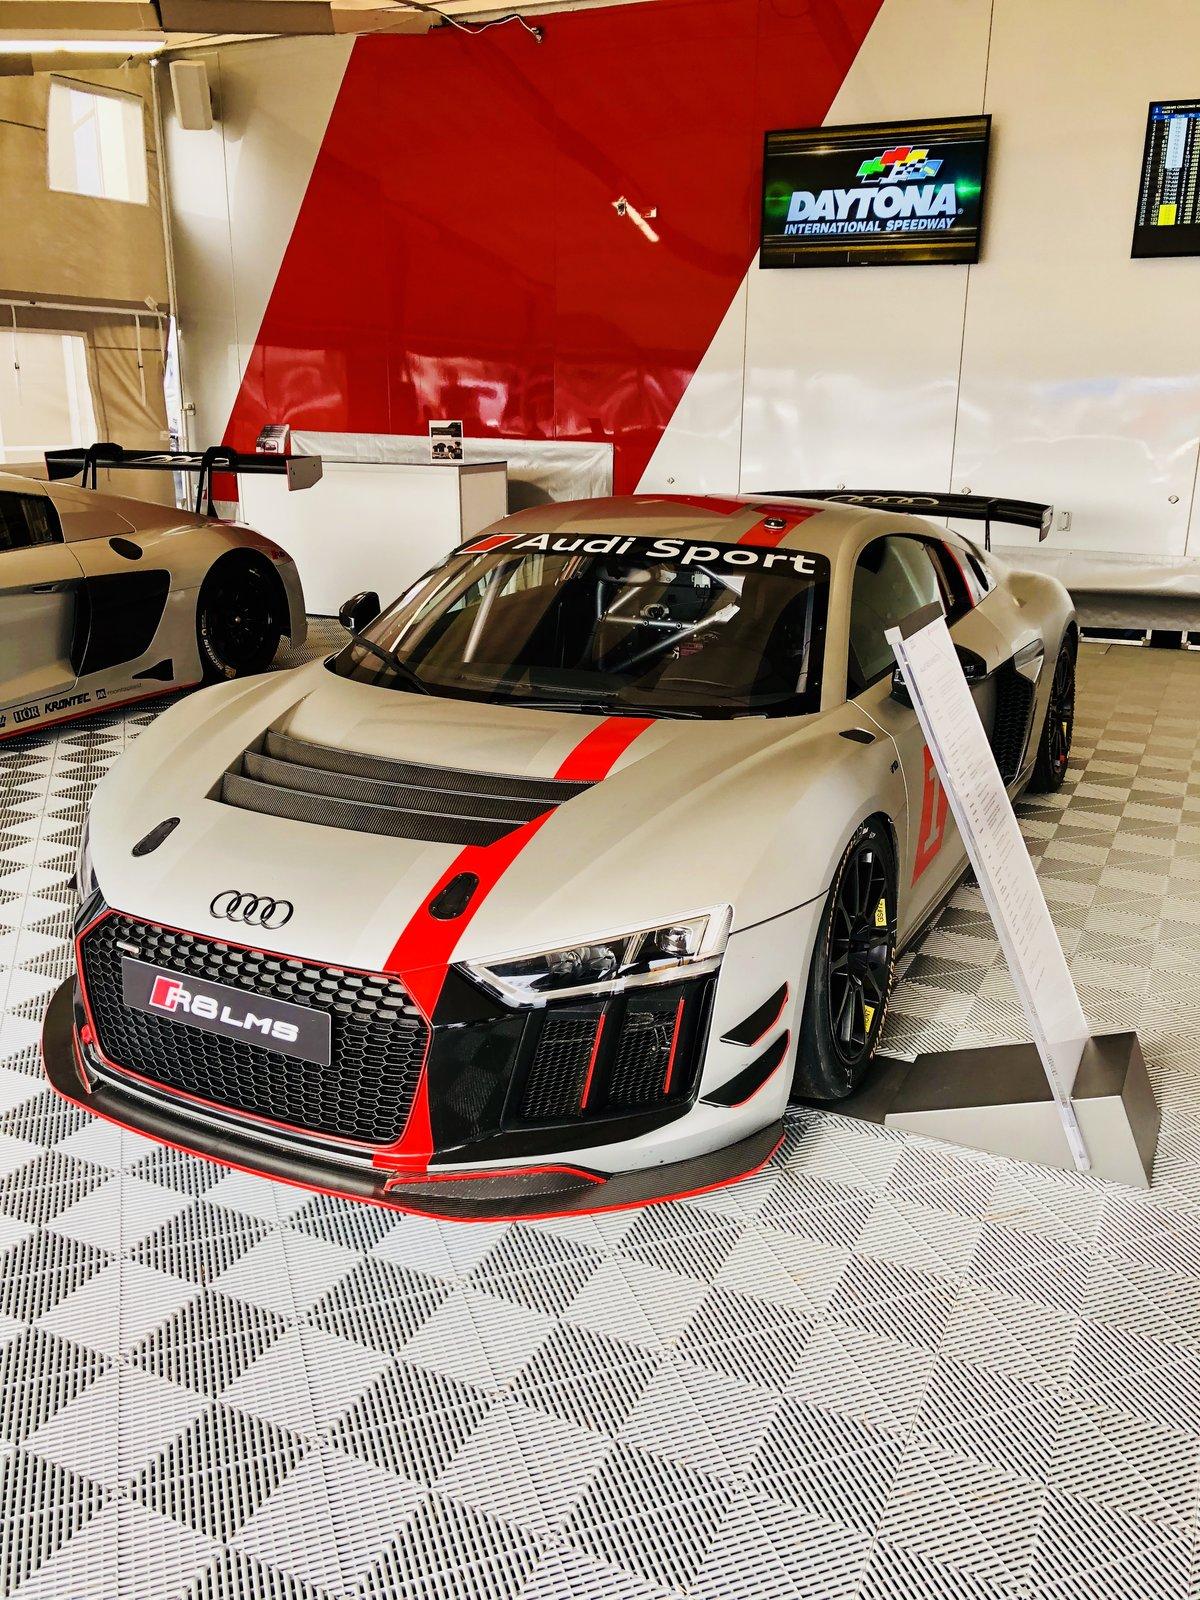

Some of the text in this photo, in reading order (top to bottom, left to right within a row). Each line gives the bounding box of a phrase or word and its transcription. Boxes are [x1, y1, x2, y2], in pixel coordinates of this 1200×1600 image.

[786, 183, 957, 222] DAYTONA
[784, 217, 956, 235] INTERNATIONAL SPEEDWAY
[512, 533, 816, 574] Audi Sport
[164, 986, 300, 1043] R8 LMS
